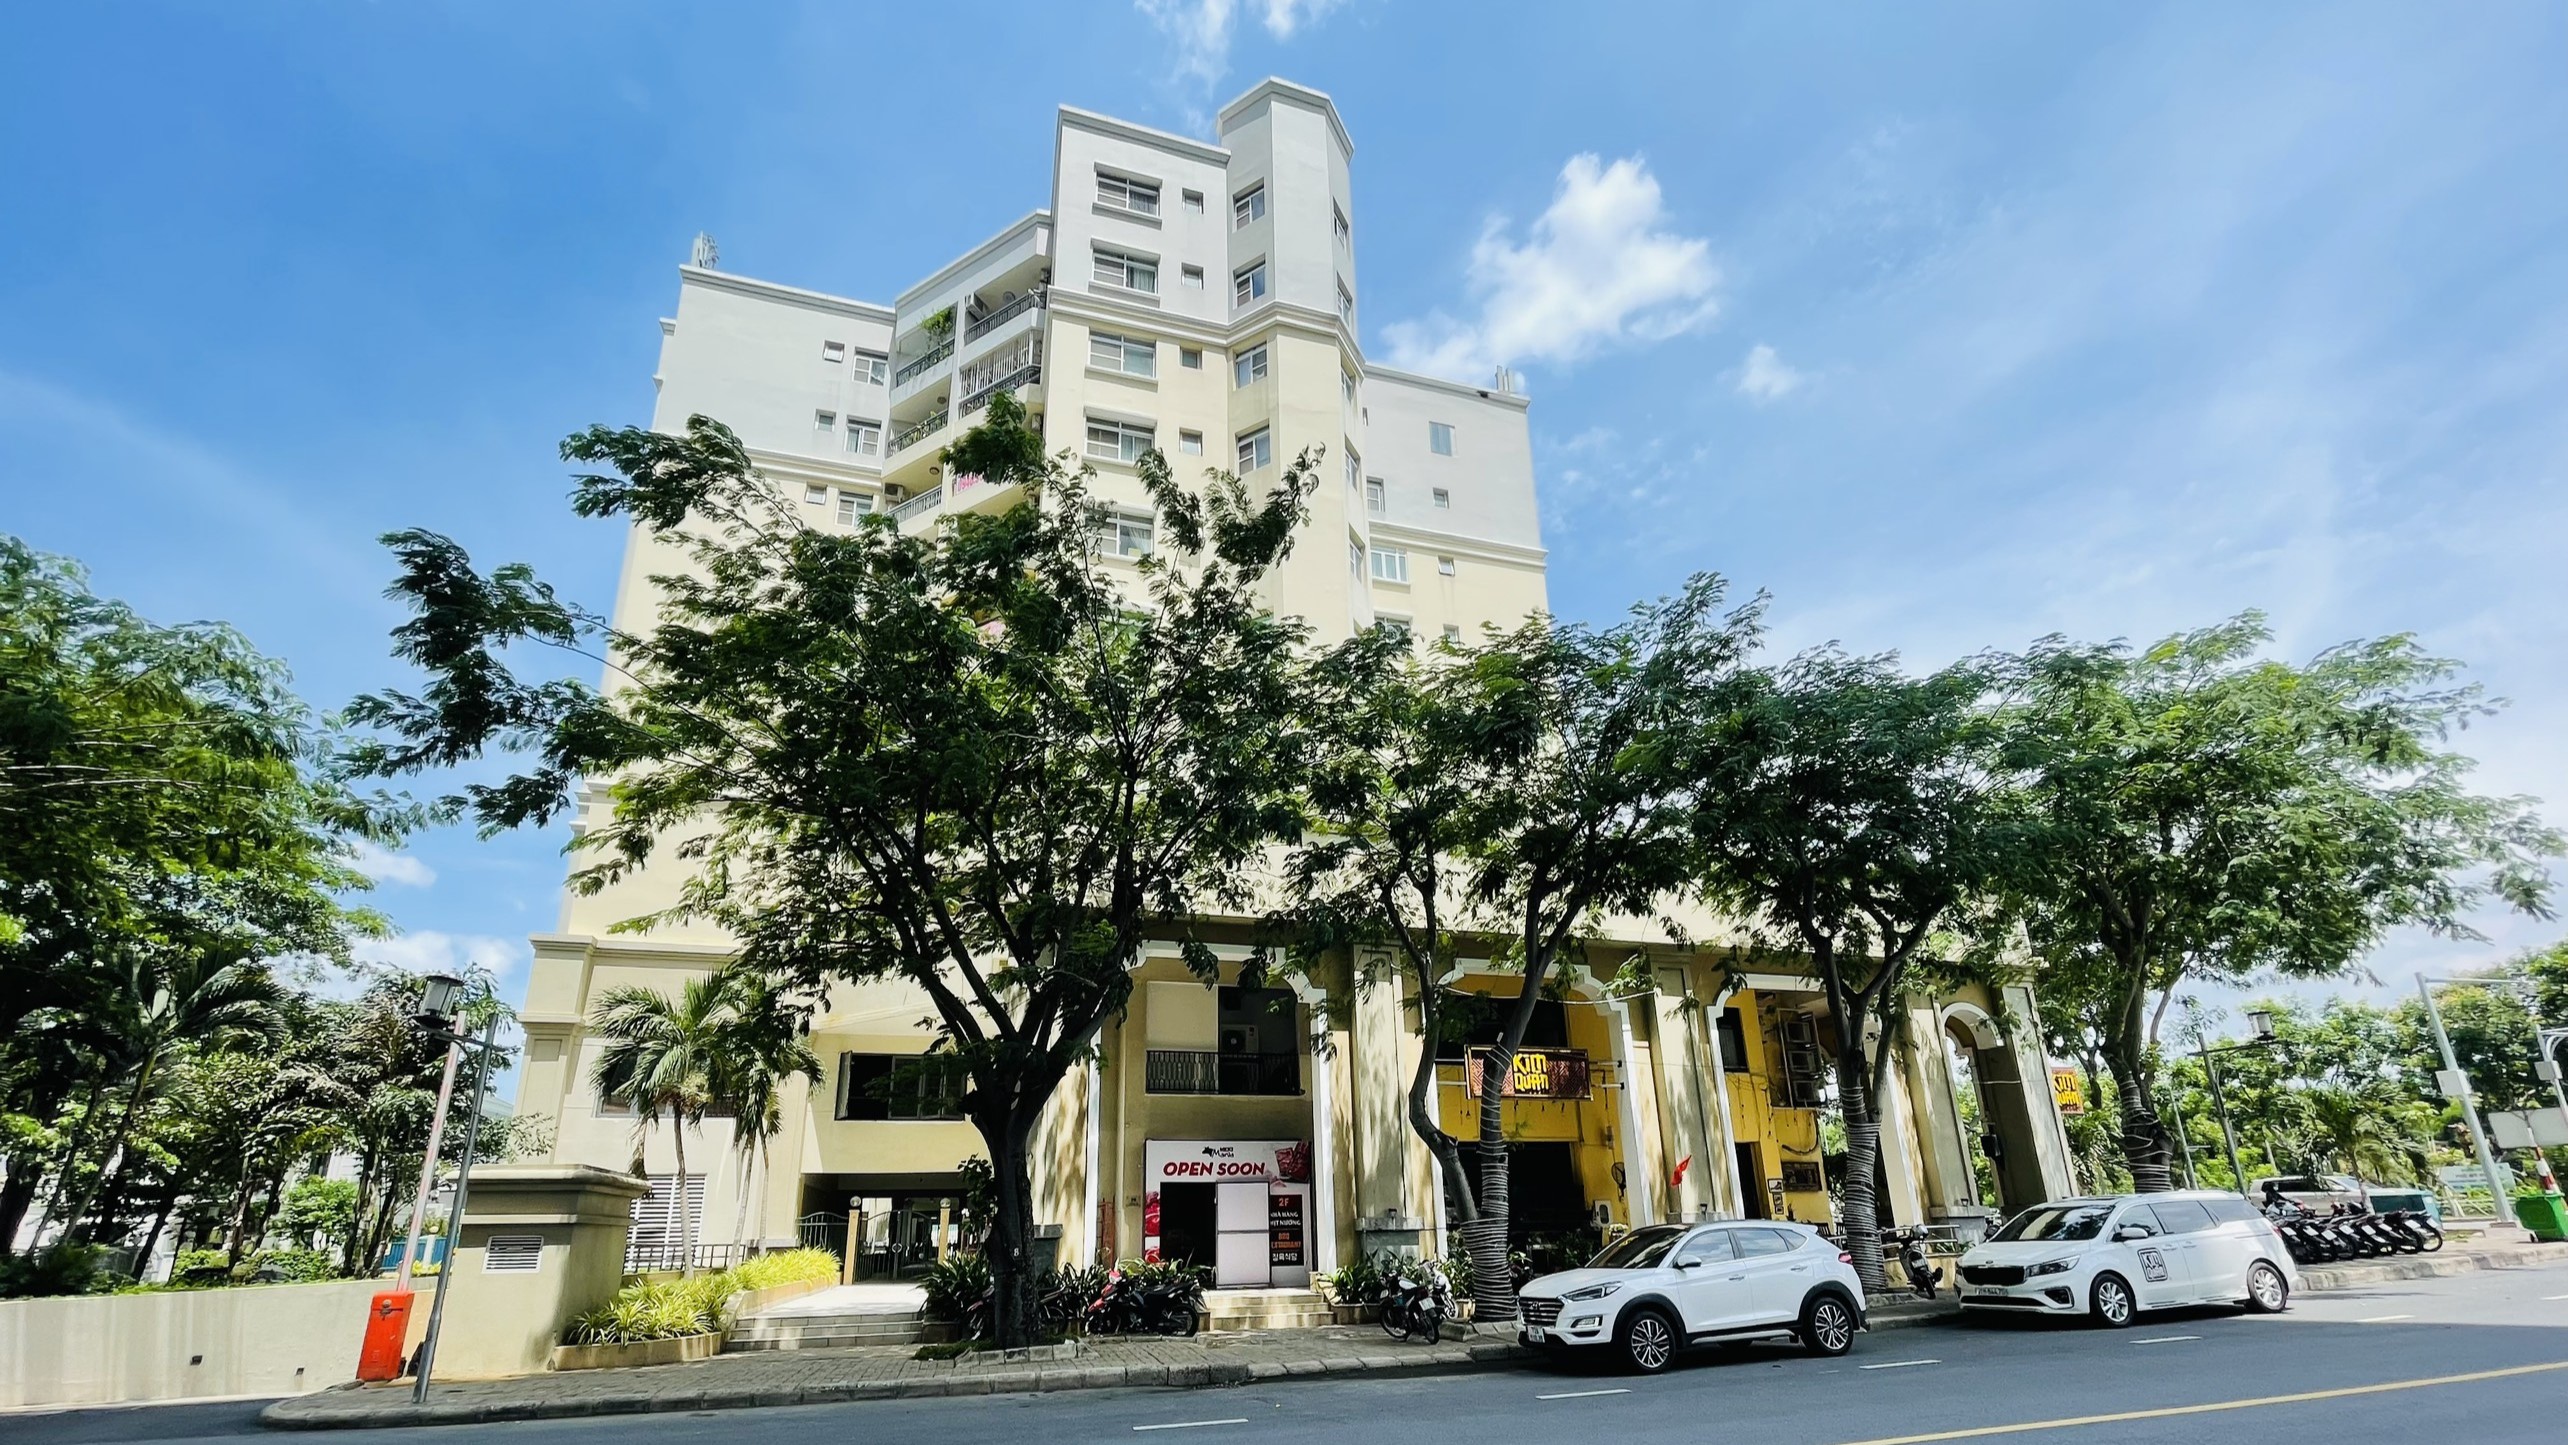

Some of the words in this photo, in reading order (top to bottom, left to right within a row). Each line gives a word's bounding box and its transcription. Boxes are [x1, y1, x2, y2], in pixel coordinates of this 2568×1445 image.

[1163, 1161, 1214, 1176] OPEN
[1216, 1162, 1265, 1176] SOON
[1278, 1197, 1289, 1207] 2F
